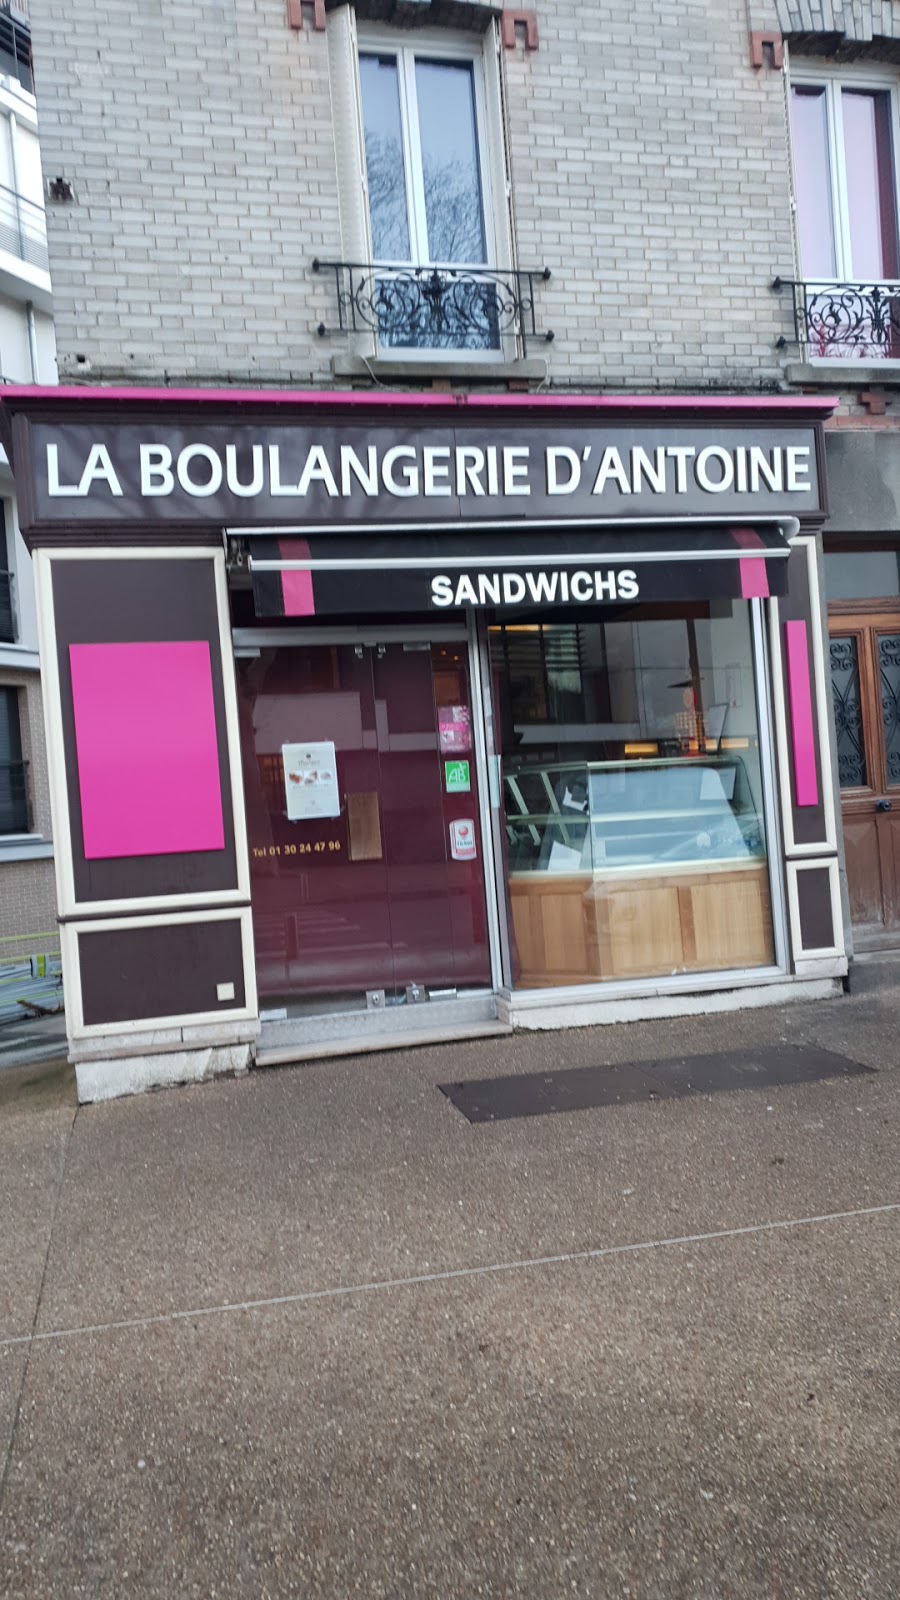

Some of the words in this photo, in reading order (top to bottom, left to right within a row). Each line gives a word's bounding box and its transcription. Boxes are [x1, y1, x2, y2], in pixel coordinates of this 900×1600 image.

[46, 443, 124, 497] LA
[139, 443, 531, 497] BOULANGERIE
[546, 445, 811, 496] D'ANTOINE
[431, 569, 640, 607] SANDWICHS
[269, 846, 281, 856] 01
[284, 844, 297, 855] 30
[300, 843, 312, 853] 24
[314, 841, 326, 852] 47
[328, 840, 341, 851] 96
